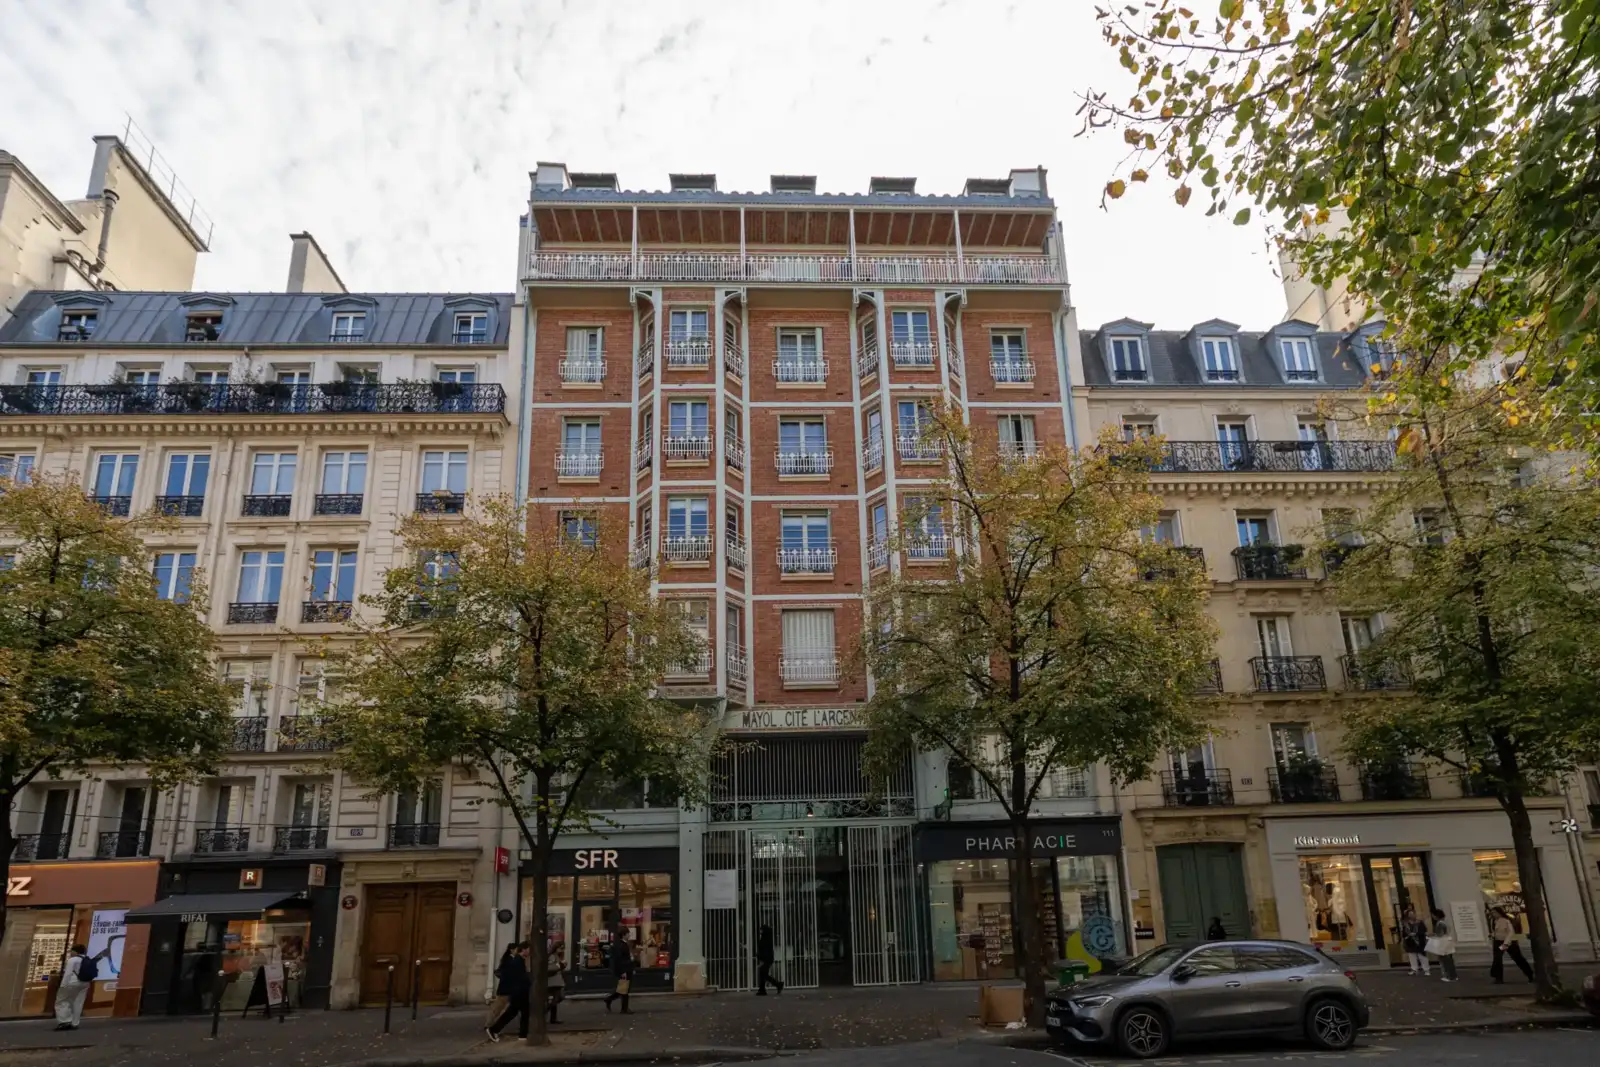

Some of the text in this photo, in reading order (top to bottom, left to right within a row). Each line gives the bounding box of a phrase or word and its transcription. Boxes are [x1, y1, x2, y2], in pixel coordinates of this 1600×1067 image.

[785, 709, 809, 727] CITÉ
[965, 834, 1077, 851] PHARACIE
[1294, 834, 1360, 846] Kids around
[574, 849, 619, 870] SFR
[247, 871, 256, 881] R
